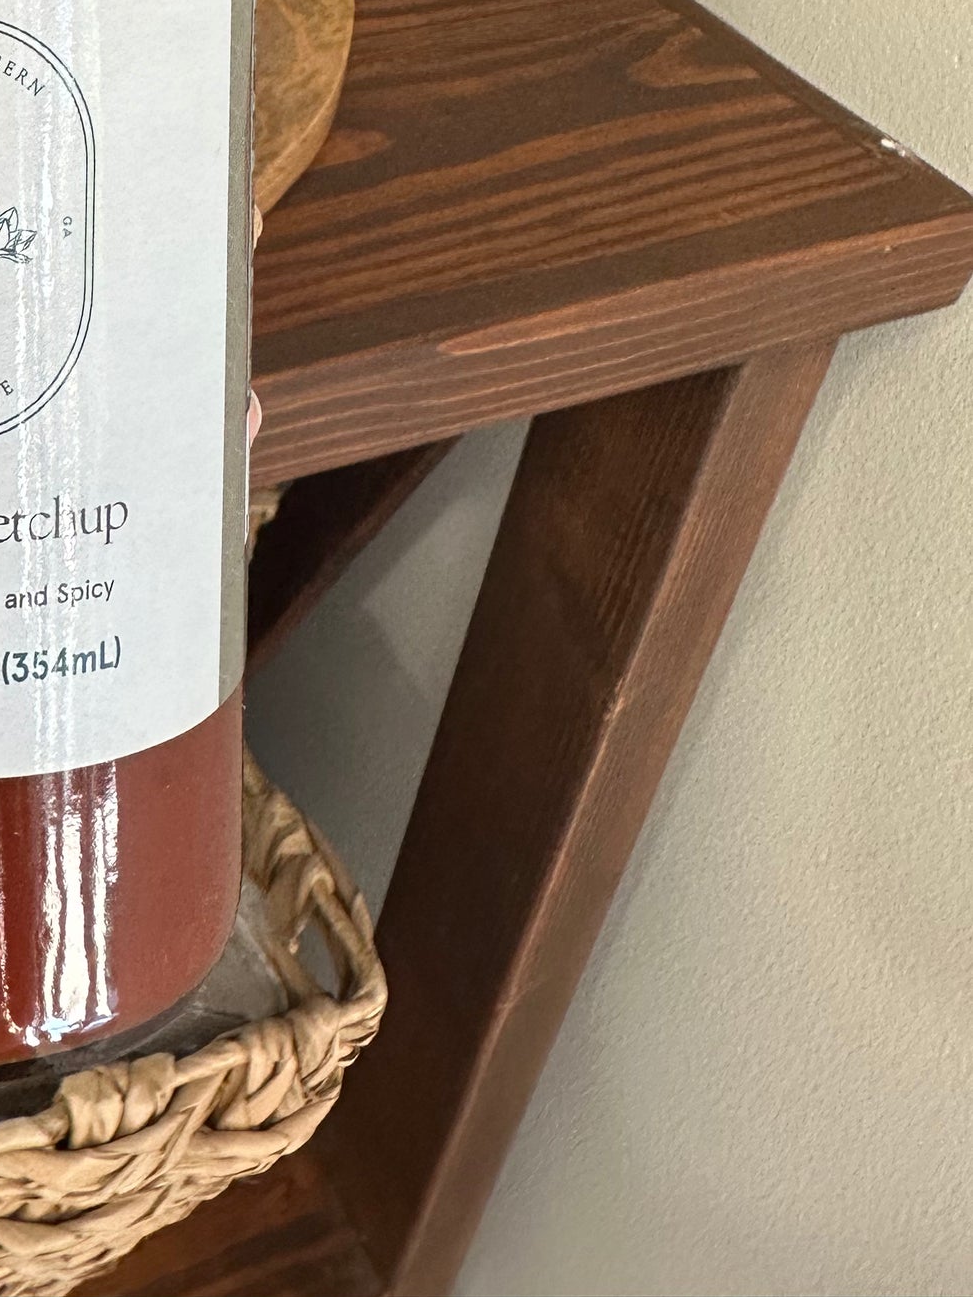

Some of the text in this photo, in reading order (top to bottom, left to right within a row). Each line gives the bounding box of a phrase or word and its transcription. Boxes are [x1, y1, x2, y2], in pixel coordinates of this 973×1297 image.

[61, 215, 73, 238] GA
[4, 582, 48, 609] and
[57, 578, 115, 608] Spicy
[2, 635, 122, 686] (354mL)
